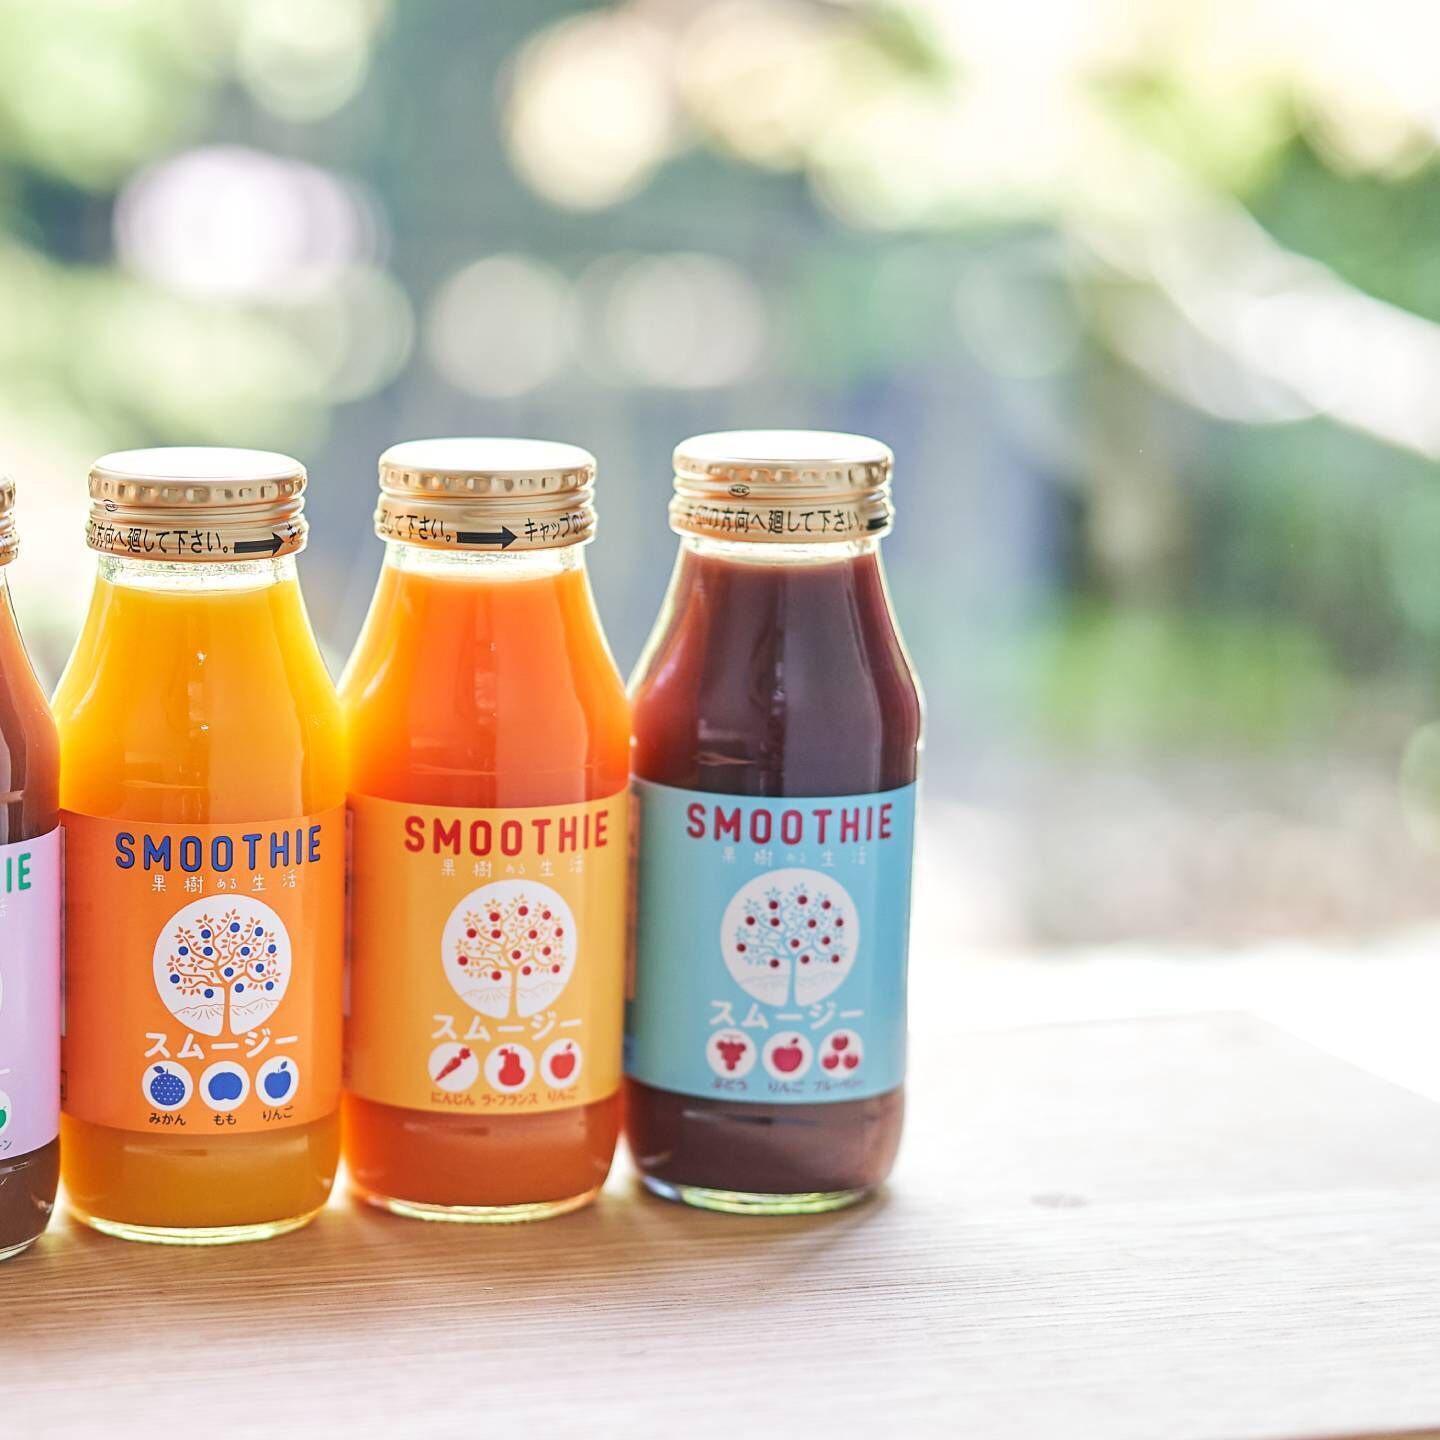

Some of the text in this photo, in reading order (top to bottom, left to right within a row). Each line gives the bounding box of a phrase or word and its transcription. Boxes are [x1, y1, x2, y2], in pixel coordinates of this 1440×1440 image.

[404, 810, 609, 857] SMOOTHIE
[686, 803, 893, 846] SMOOTHIE
[115, 824, 322, 873] SMOOTHIE
[152, 869, 297, 894] 果樹ある生活
[431, 1011, 583, 1042] スムージー
[709, 1000, 865, 1030] スムージー
[144, 1028, 298, 1061] スムージー
[431, 1091, 474, 1106] にんじん
[768, 1080, 805, 1093] りんご
[149, 1105, 295, 1126] みかん もも りんご
